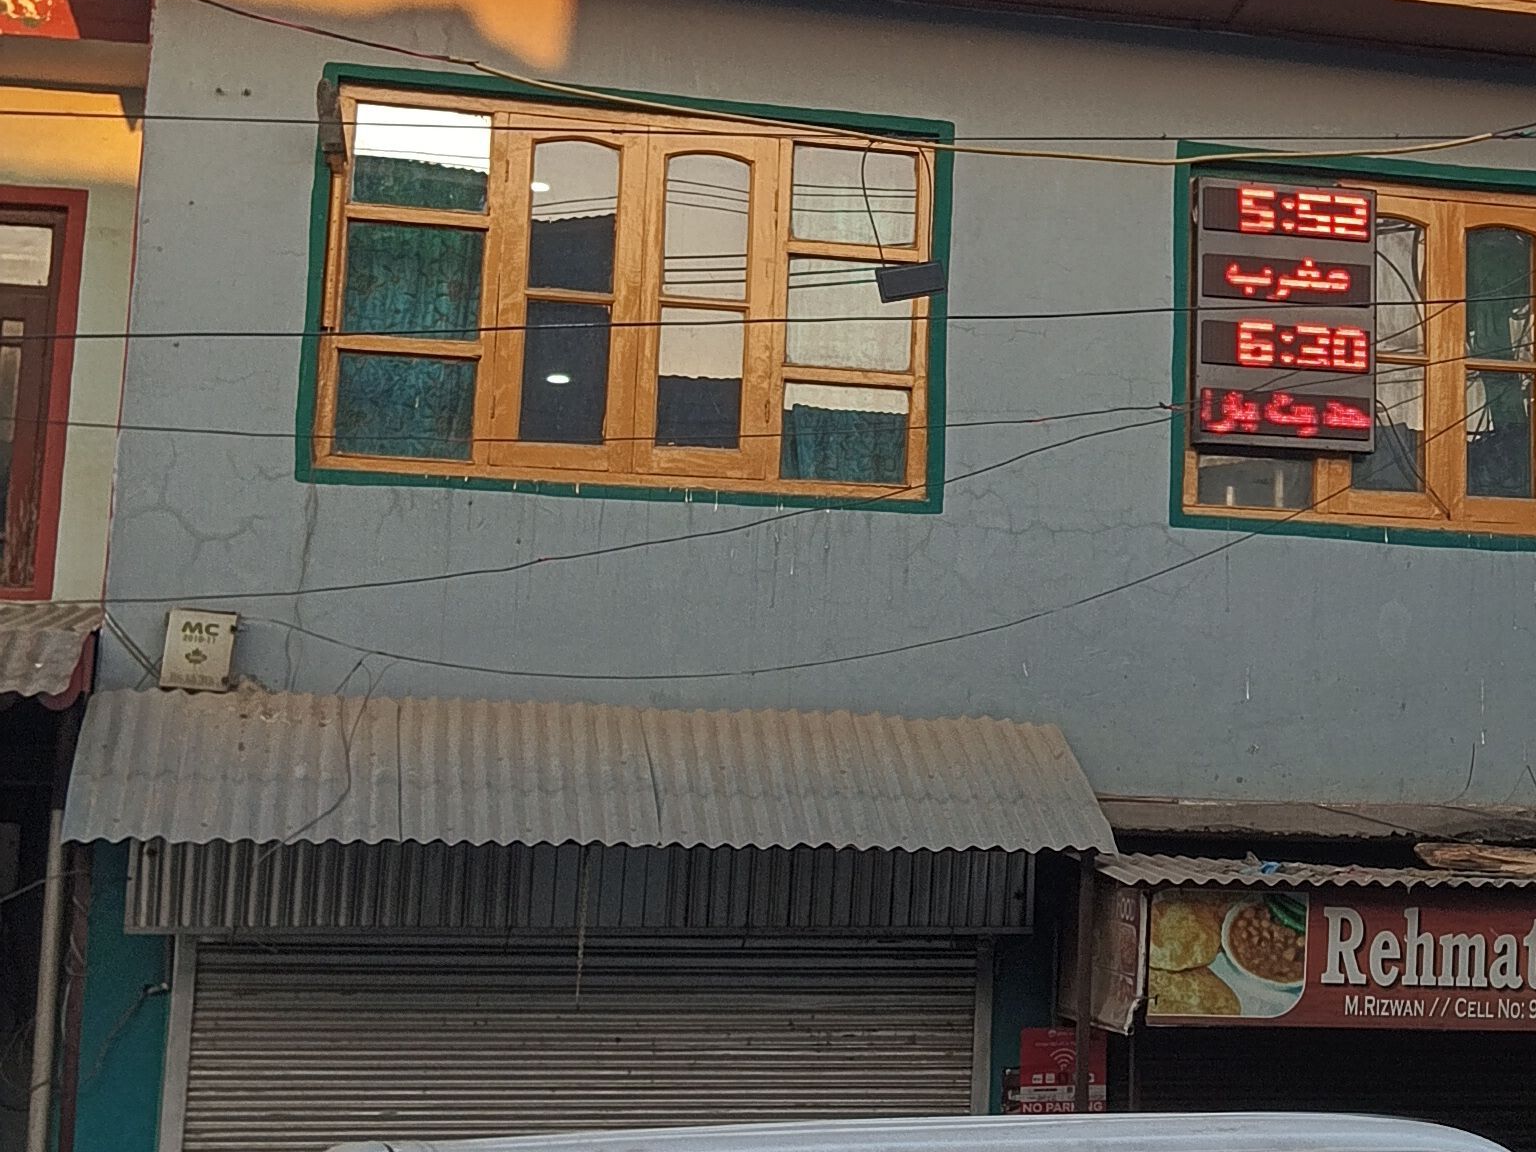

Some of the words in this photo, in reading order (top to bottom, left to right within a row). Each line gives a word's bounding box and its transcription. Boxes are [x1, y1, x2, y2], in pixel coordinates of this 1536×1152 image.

[1238, 187, 1369, 239] 5:52
[1226, 257, 1349, 301] مغرب
[1238, 320, 1368, 371] 6:30
[181, 621, 220, 636] MC
[1022, 1102, 1043, 1113] NO
